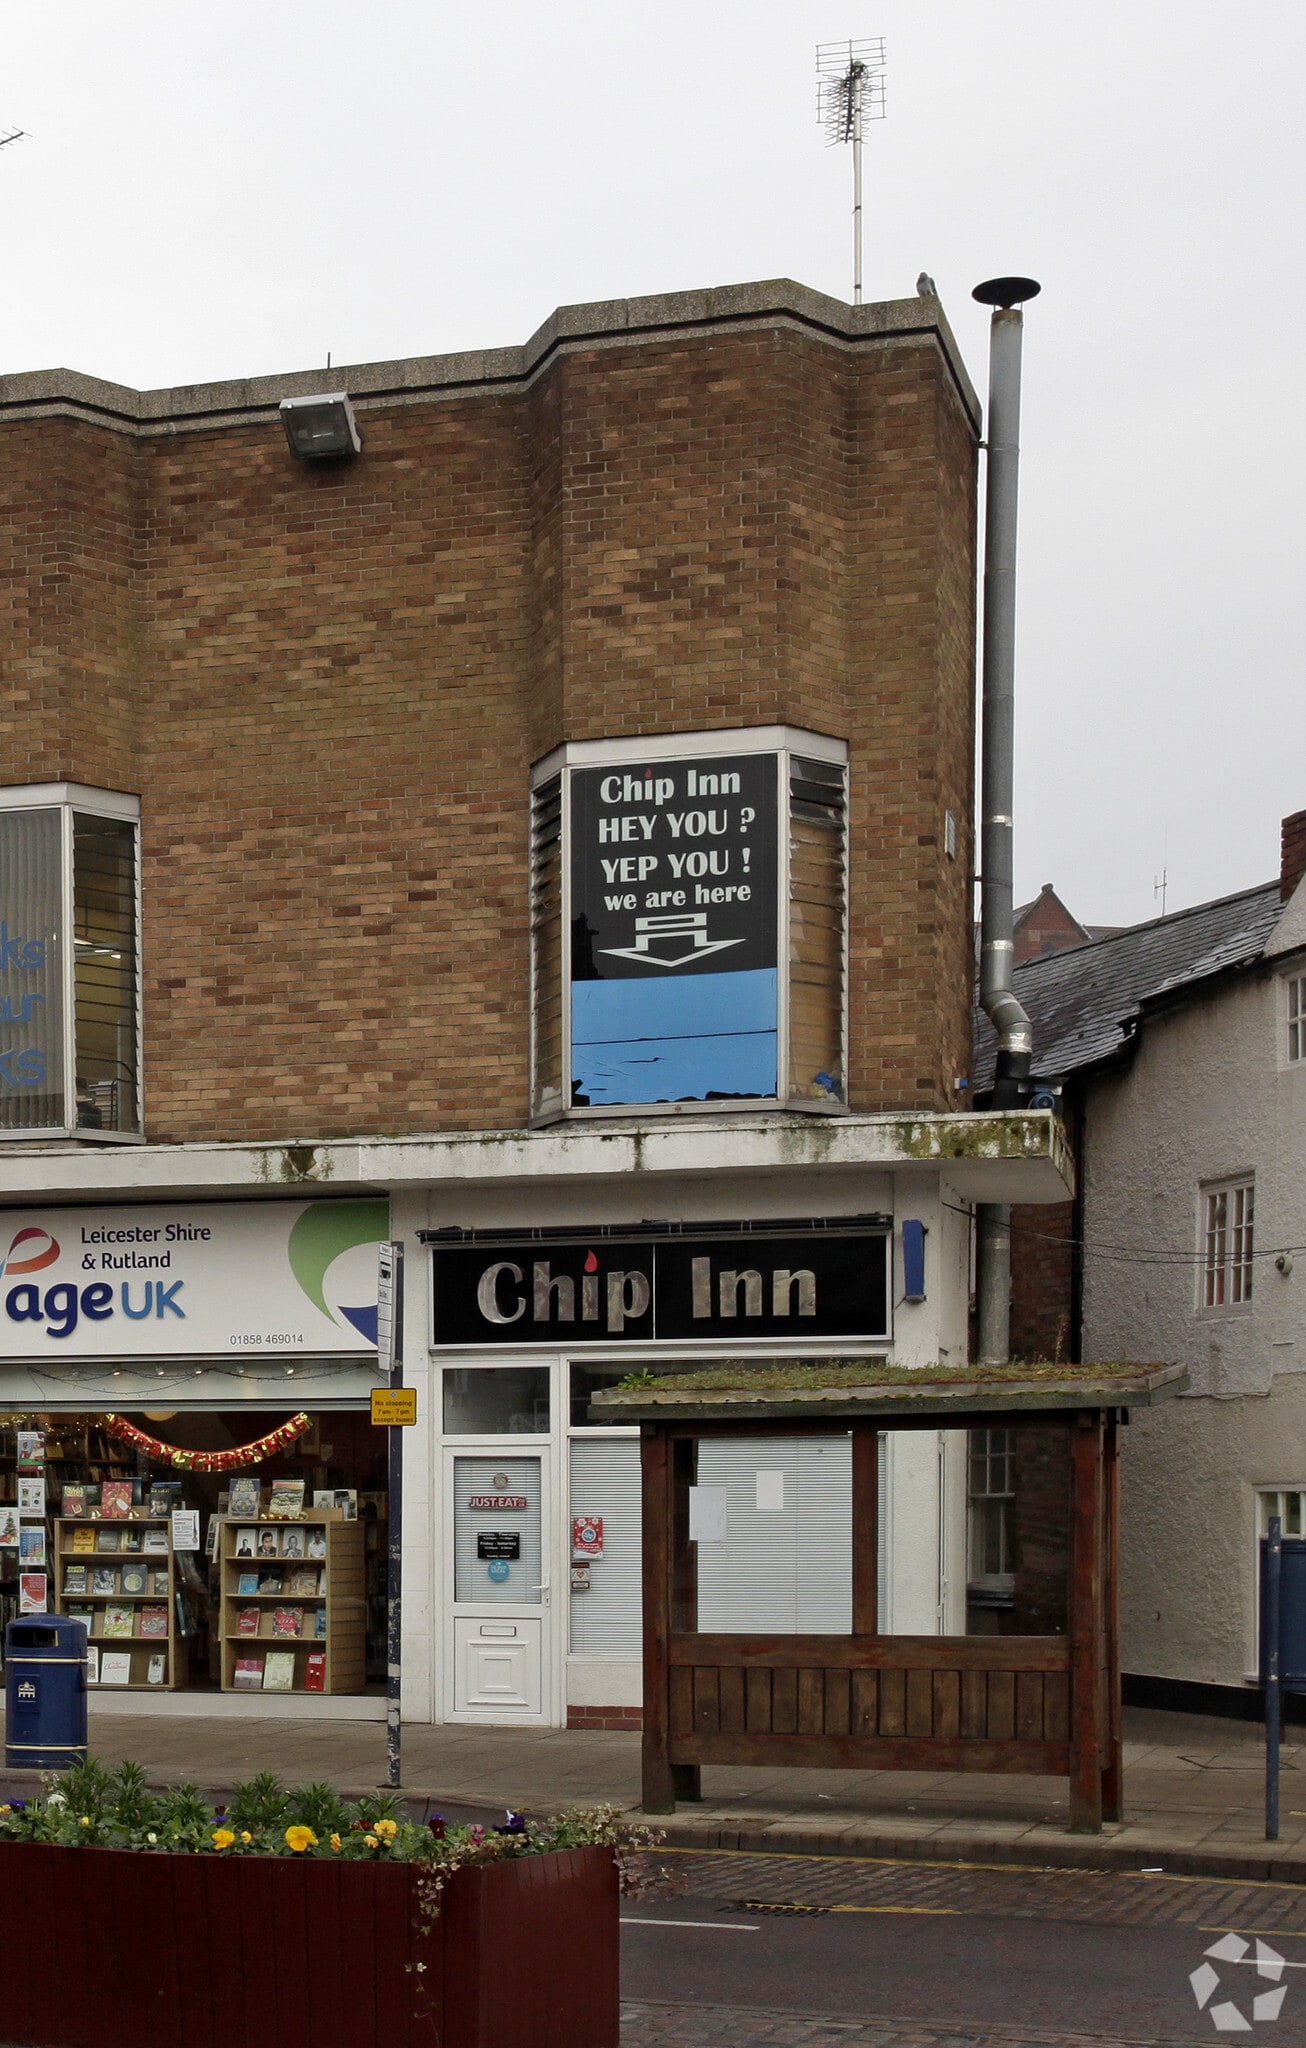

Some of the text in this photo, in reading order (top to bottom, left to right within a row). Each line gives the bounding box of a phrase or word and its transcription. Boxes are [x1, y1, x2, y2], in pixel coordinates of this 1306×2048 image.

[600, 768, 741, 805] Chip Inn
[598, 807, 756, 843] HEY YOU ?
[600, 847, 751, 883] YEP YOU !
[604, 884, 751, 911] we are here
[80, 1223, 211, 1244] Leicester Shire
[81, 1250, 171, 1270] & Rutland
[477, 1249, 816, 1332] Chip Inn
[5, 1279, 187, 1339] age UK
[229, 1333, 304, 1345] 01858 469014
[470, 1497, 497, 1507] JUST
[498, 1497, 519, 1507] EAT
